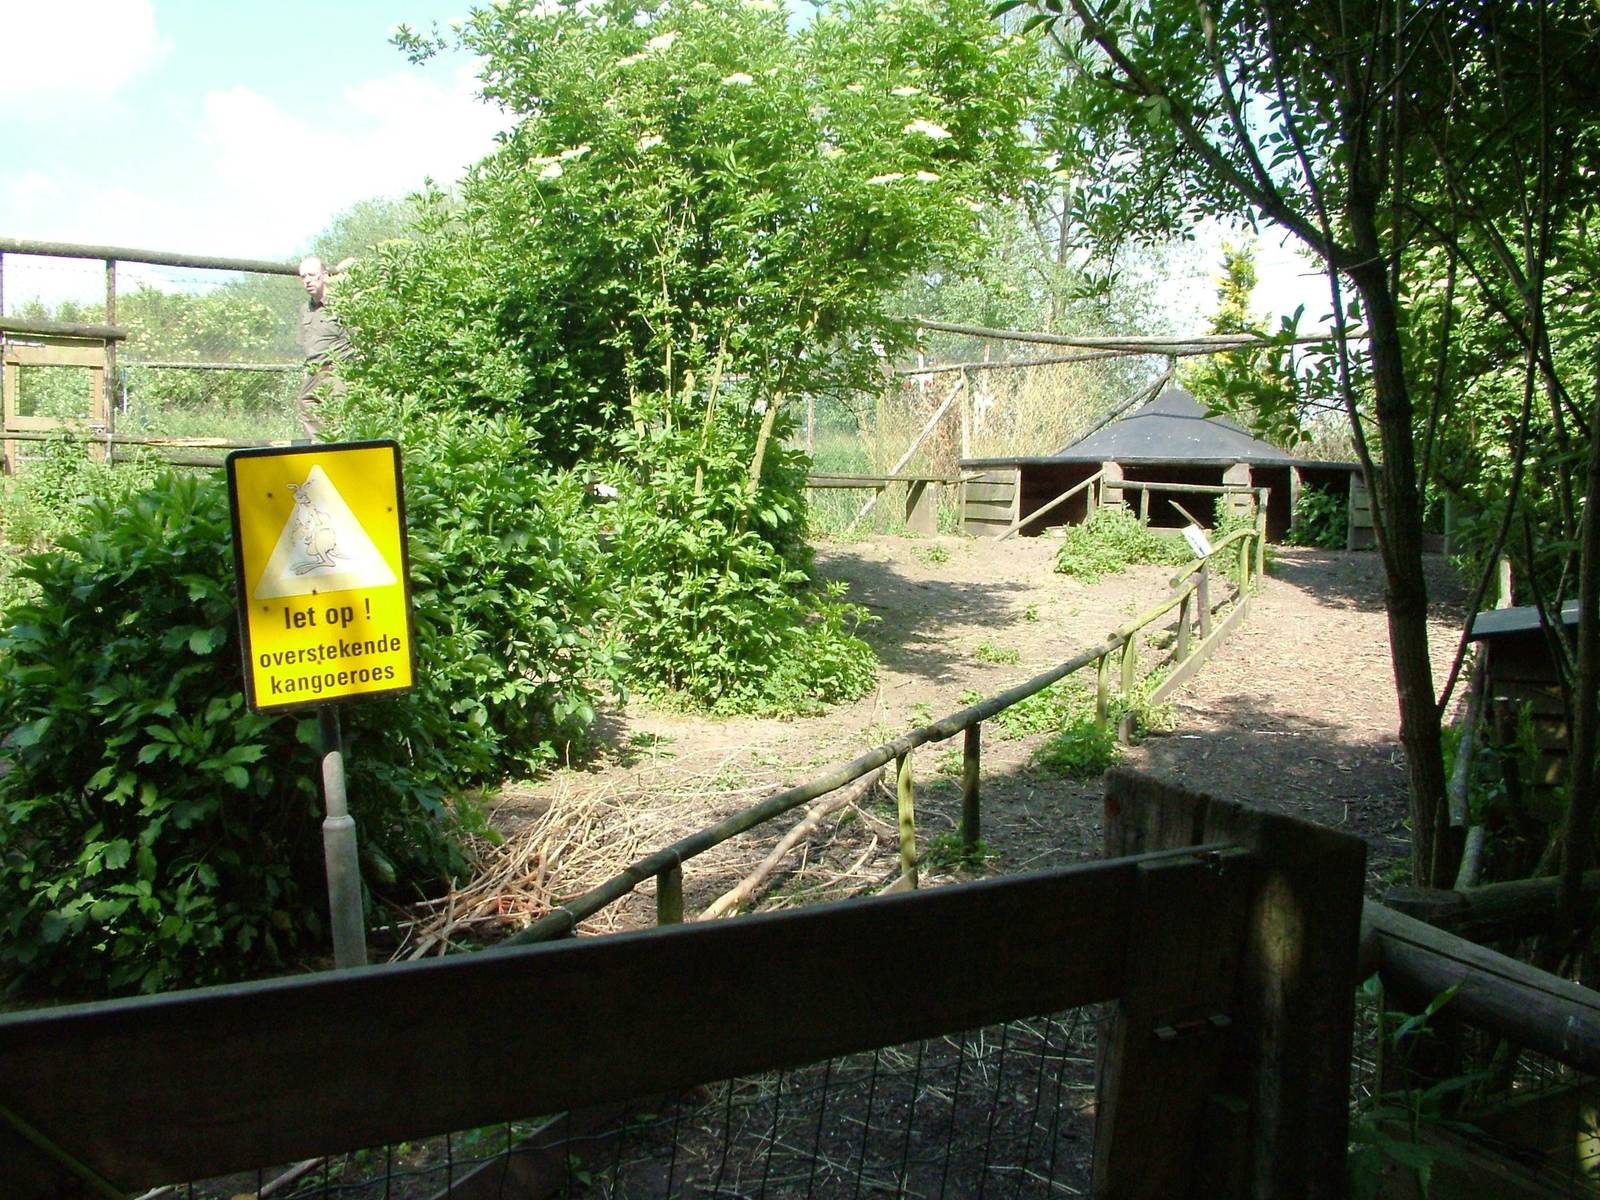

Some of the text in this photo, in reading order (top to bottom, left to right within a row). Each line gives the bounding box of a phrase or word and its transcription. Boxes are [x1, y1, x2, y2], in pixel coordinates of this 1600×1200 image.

[284, 598, 371, 630] let op !
[260, 634, 401, 668] overstekende
[271, 664, 395, 695] kangoeroes
